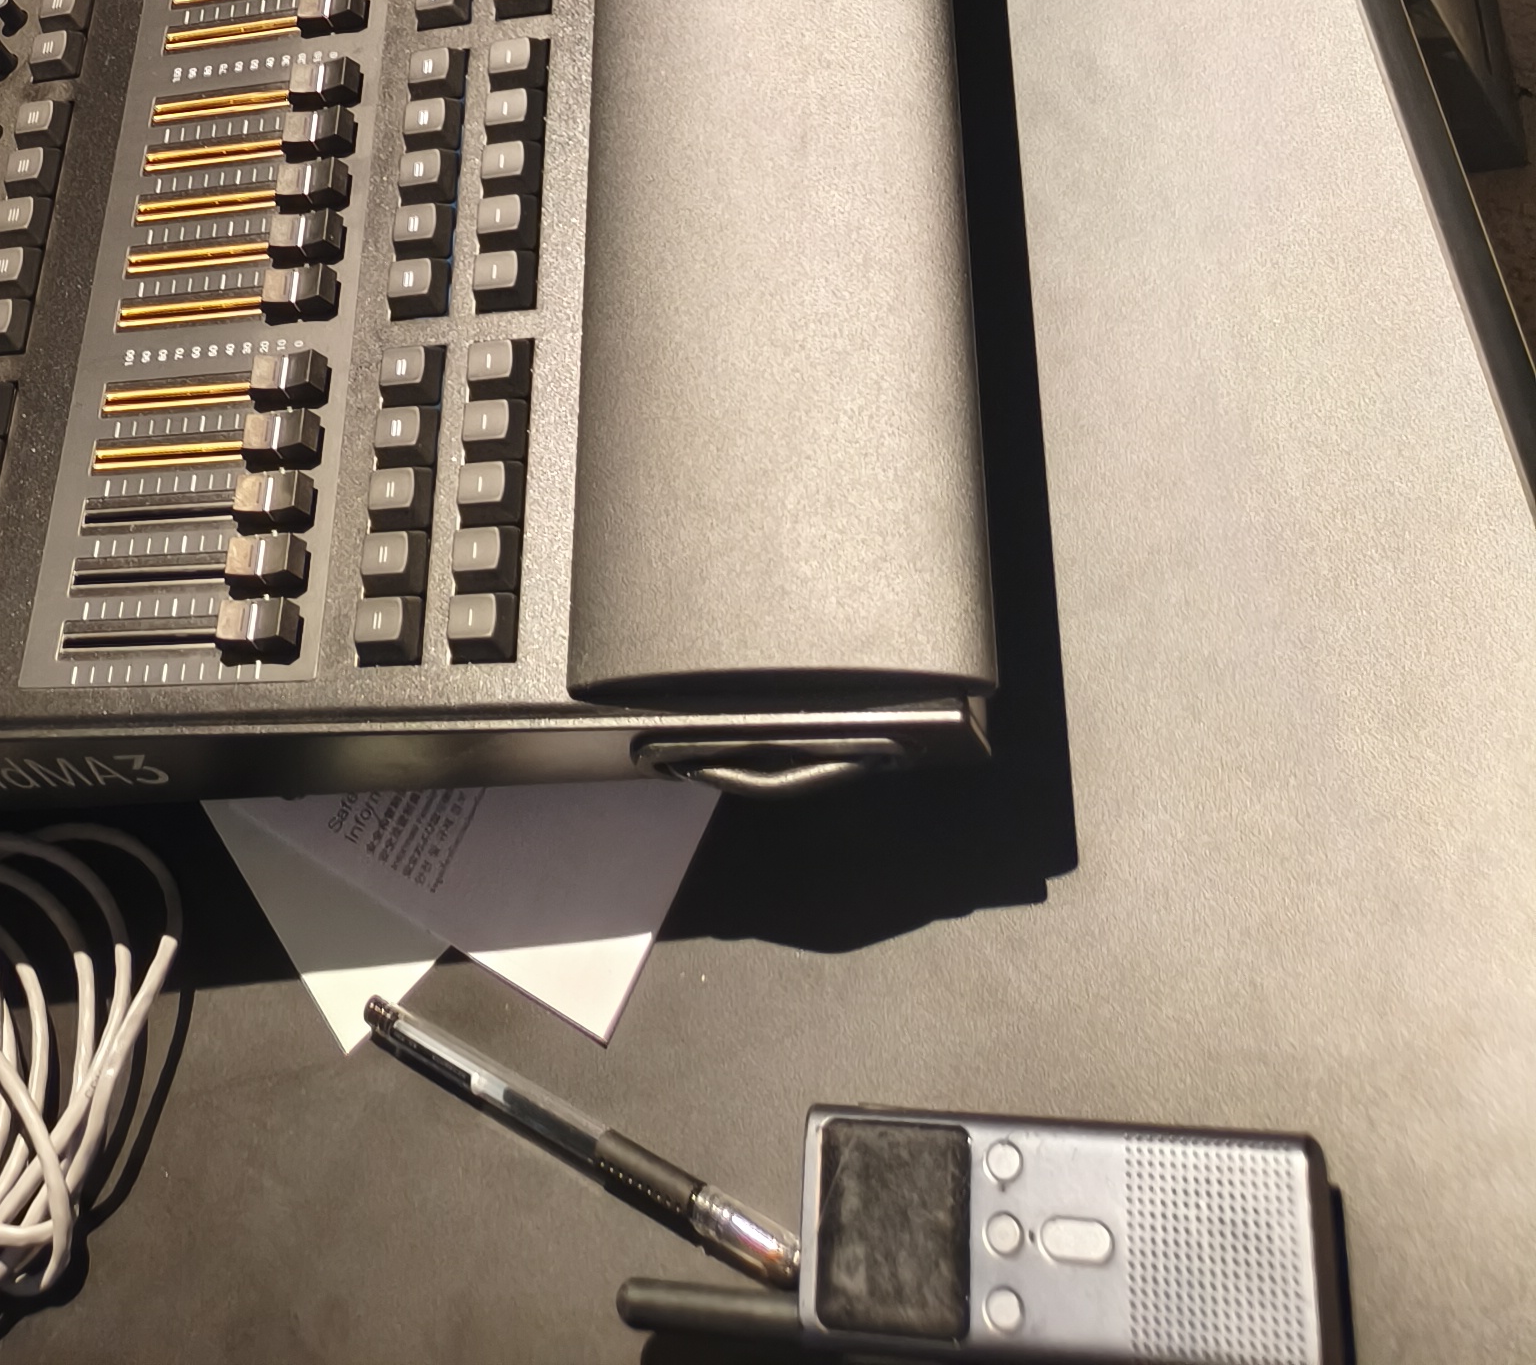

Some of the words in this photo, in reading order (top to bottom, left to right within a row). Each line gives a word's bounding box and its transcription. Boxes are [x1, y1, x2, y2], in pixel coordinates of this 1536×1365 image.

[225, 343, 235, 357] 40
[259, 340, 270, 354] 20
[276, 338, 287, 352] 10
[293, 339, 304, 348] 0
[124, 349, 136, 367] 100
[174, 347, 185, 361] 70
